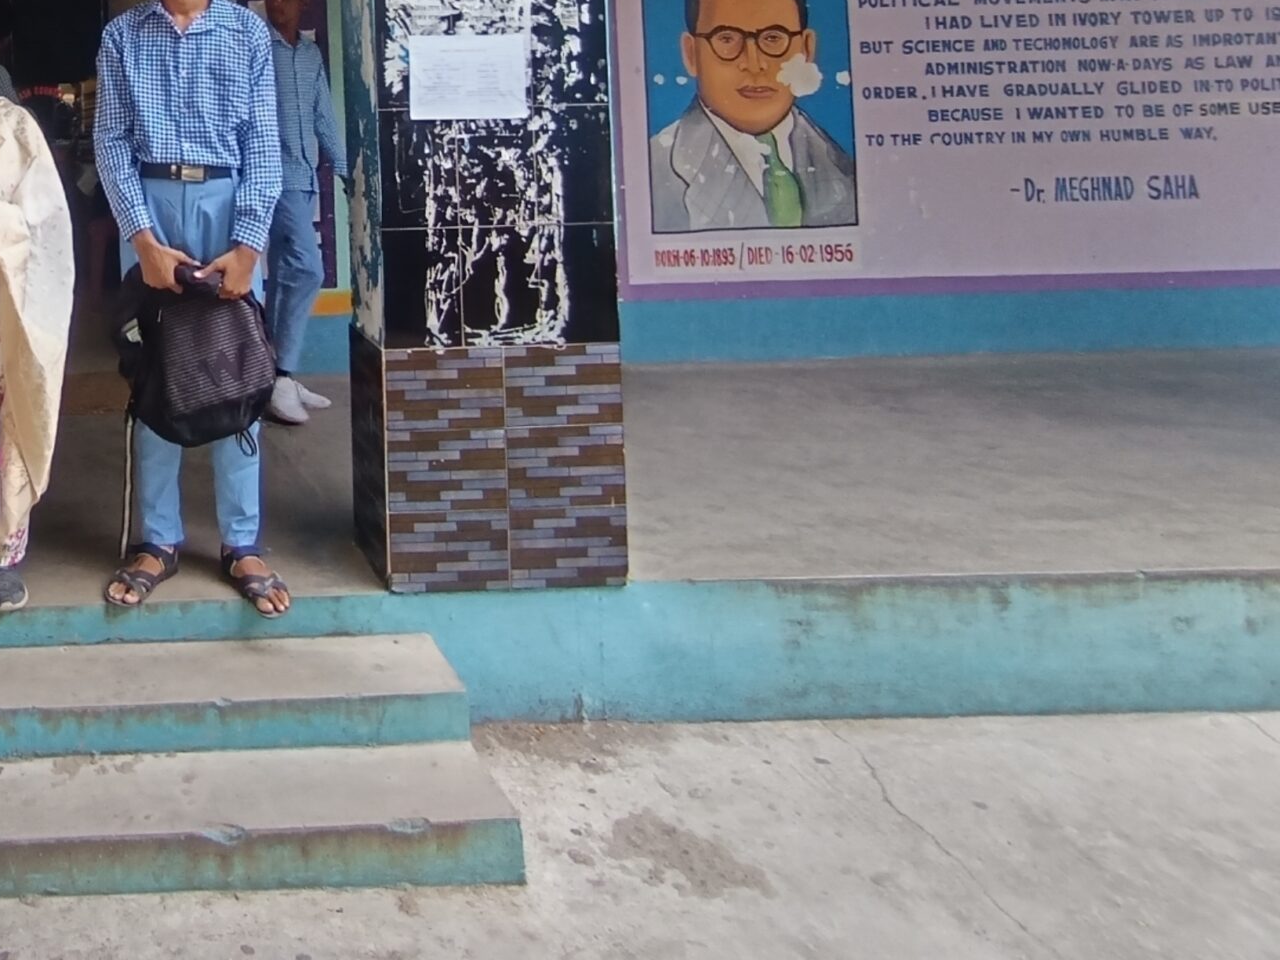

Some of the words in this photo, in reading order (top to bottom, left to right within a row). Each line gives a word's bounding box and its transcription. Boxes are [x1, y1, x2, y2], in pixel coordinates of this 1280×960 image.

[925, 16, 930, 30] I
[935, 15, 972, 30] HAD
[980, 13, 1039, 28] LIVED
[1048, 13, 1066, 27] IN
[1073, 11, 1122, 26] IVORY
[1130, 9, 1196, 25] TOWER
[1204, 8, 1224, 22] UP
[1231, 7, 1254, 22] TO
[860, 40, 893, 54] BUT
[902, 39, 975, 55] SCIENCE
[983, 38, 1007, 51] AND
[1129, 35, 1159, 48] ARE
[1166, 35, 1183, 48] AS
[925, 60, 1066, 76] ADMINISTRATION
[1184, 56, 1205, 70] AS
[1214, 55, 1253, 68] LAW
[931, 86, 936, 98] I
[942, 84, 990, 98] HAVE
[1003, 82, 1104, 97] GRADUALLY
[1117, 80, 1182, 95] GLIDED
[928, 107, 1003, 122] BECAUSE
[1015, 108, 1021, 120] I
[1027, 105, 1104, 120] WANTED
[1114, 104, 1134, 118] TO
[1142, 103, 1165, 118] BE
[1172, 103, 1194, 117] OF
[1199, 101, 1240, 116] SOME
[1248, 101, 1280, 115] USE
[865, 134, 884, 146] TO
[890, 133, 922, 146] THE
[930, 131, 1006, 146] COUNTRY
[1011, 131, 1025, 144] IN
[1032, 131, 1054, 143] MY
[1060, 129, 1091, 142] OWN
[1099, 128, 1169, 142] HUMBLE
[1055, 176, 1135, 202] MEGHNAD
[1147, 174, 1200, 200] SAHA
